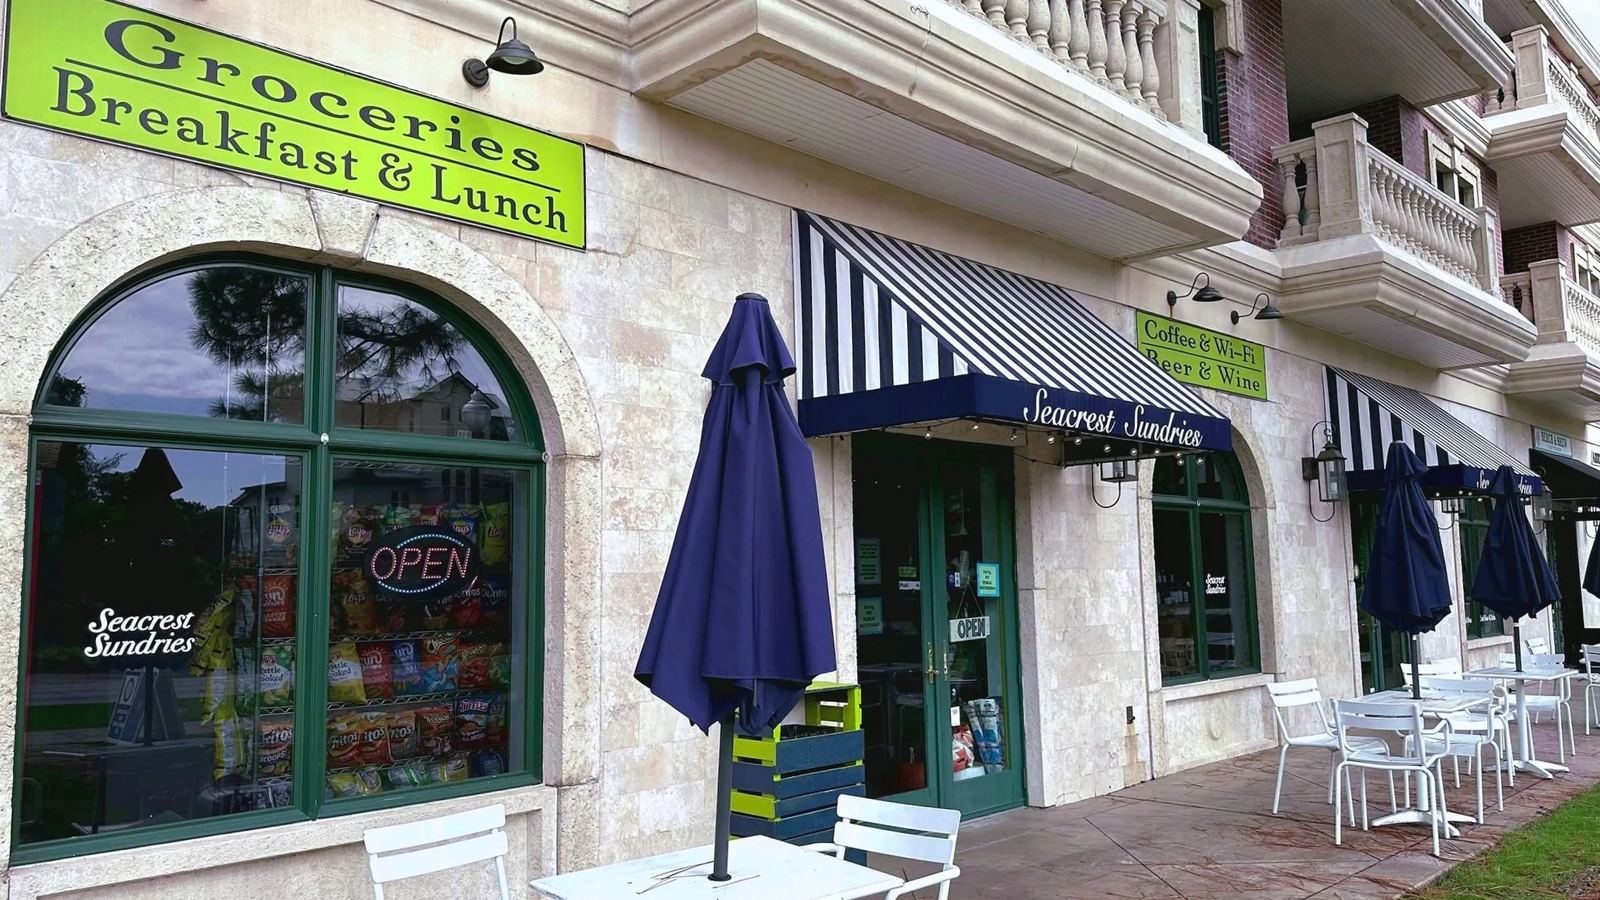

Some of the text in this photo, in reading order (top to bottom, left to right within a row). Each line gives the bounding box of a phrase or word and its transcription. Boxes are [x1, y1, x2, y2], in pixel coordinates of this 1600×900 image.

[104, 19, 540, 172] Groceries
[51, 66, 568, 233] Breakfast & Lunch
[1144, 319, 1256, 365] Coffee & Wi-Fi
[1146, 348, 1261, 392] Beer & Wine
[1024, 387, 1203, 448] Seacrest Sundries
[370, 546, 471, 580] OPEN
[88, 607, 195, 633] Seacrest
[957, 617, 986, 639] OPEN
[84, 631, 196, 658] Sundries
